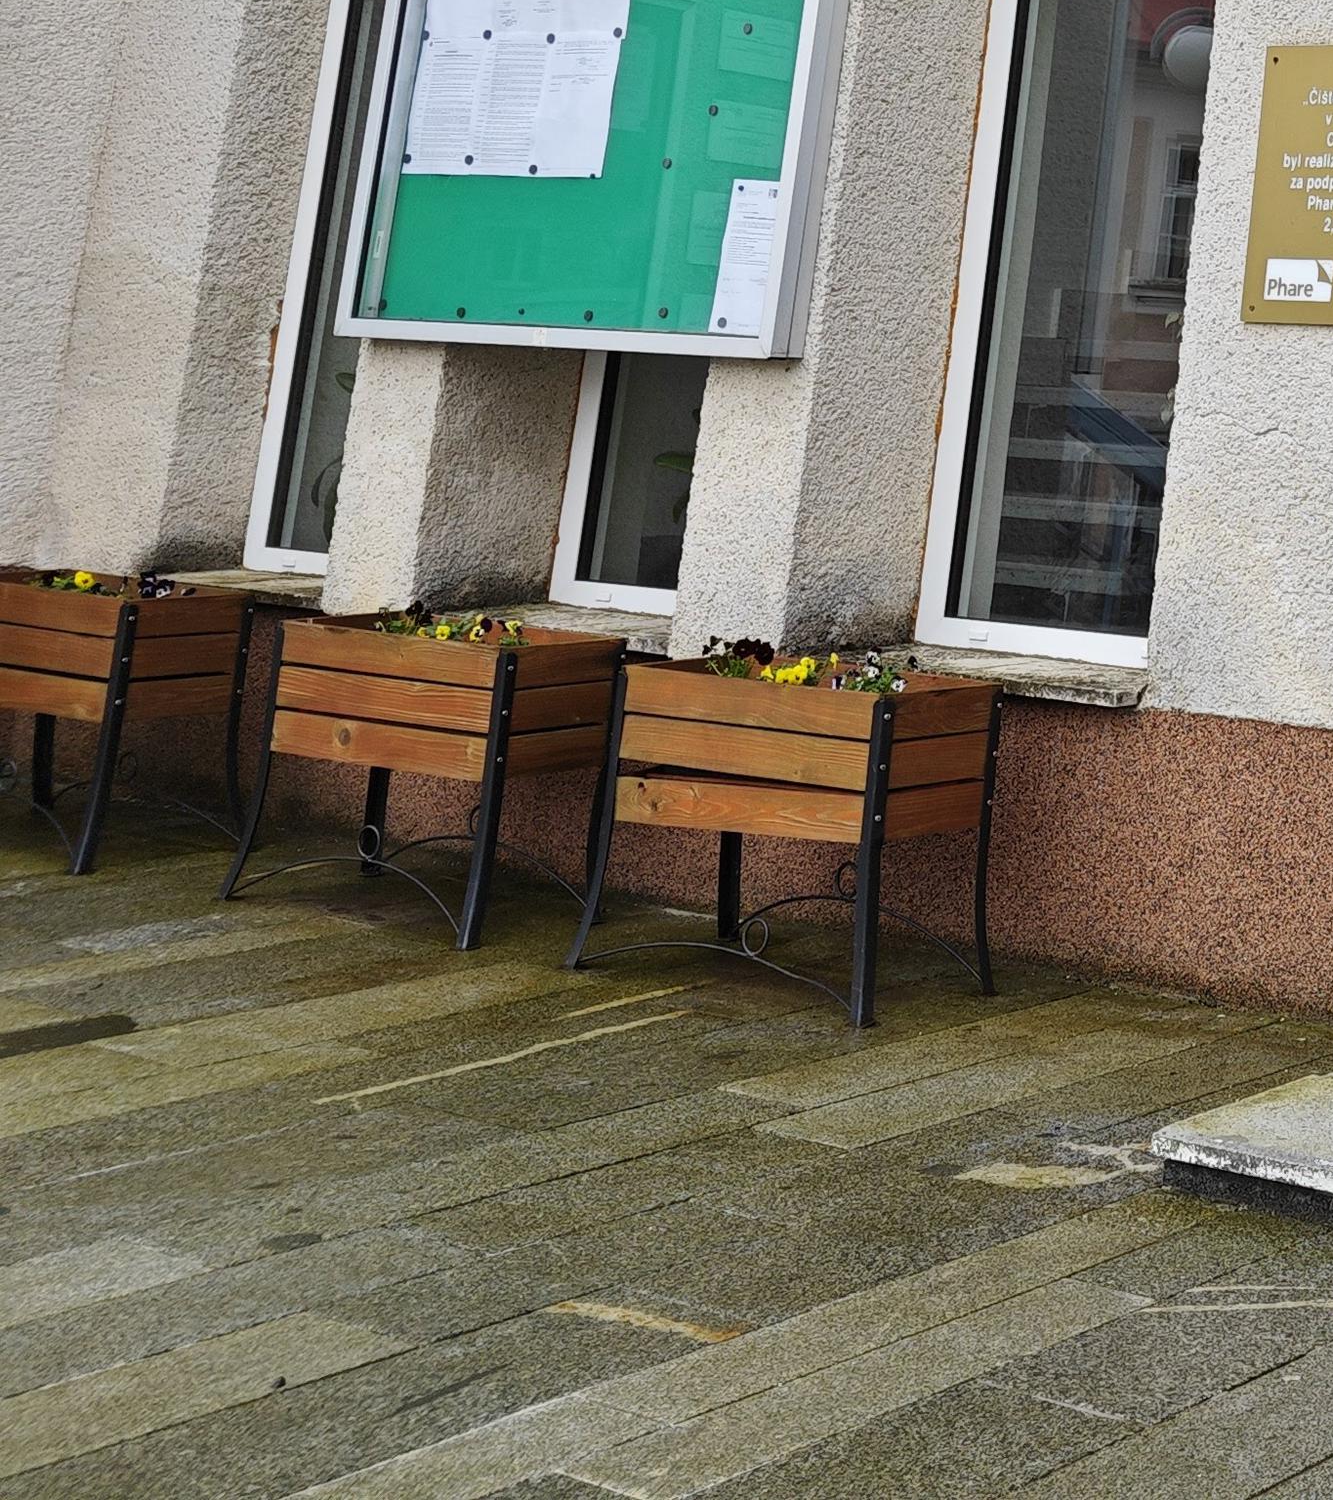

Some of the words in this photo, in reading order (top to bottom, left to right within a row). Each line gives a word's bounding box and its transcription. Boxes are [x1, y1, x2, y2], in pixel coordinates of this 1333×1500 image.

[1325, 113, 1332, 125] v
[1283, 153, 1301, 171] byl
[1290, 177, 1303, 189] za
[1267, 277, 1314, 297] Phare
